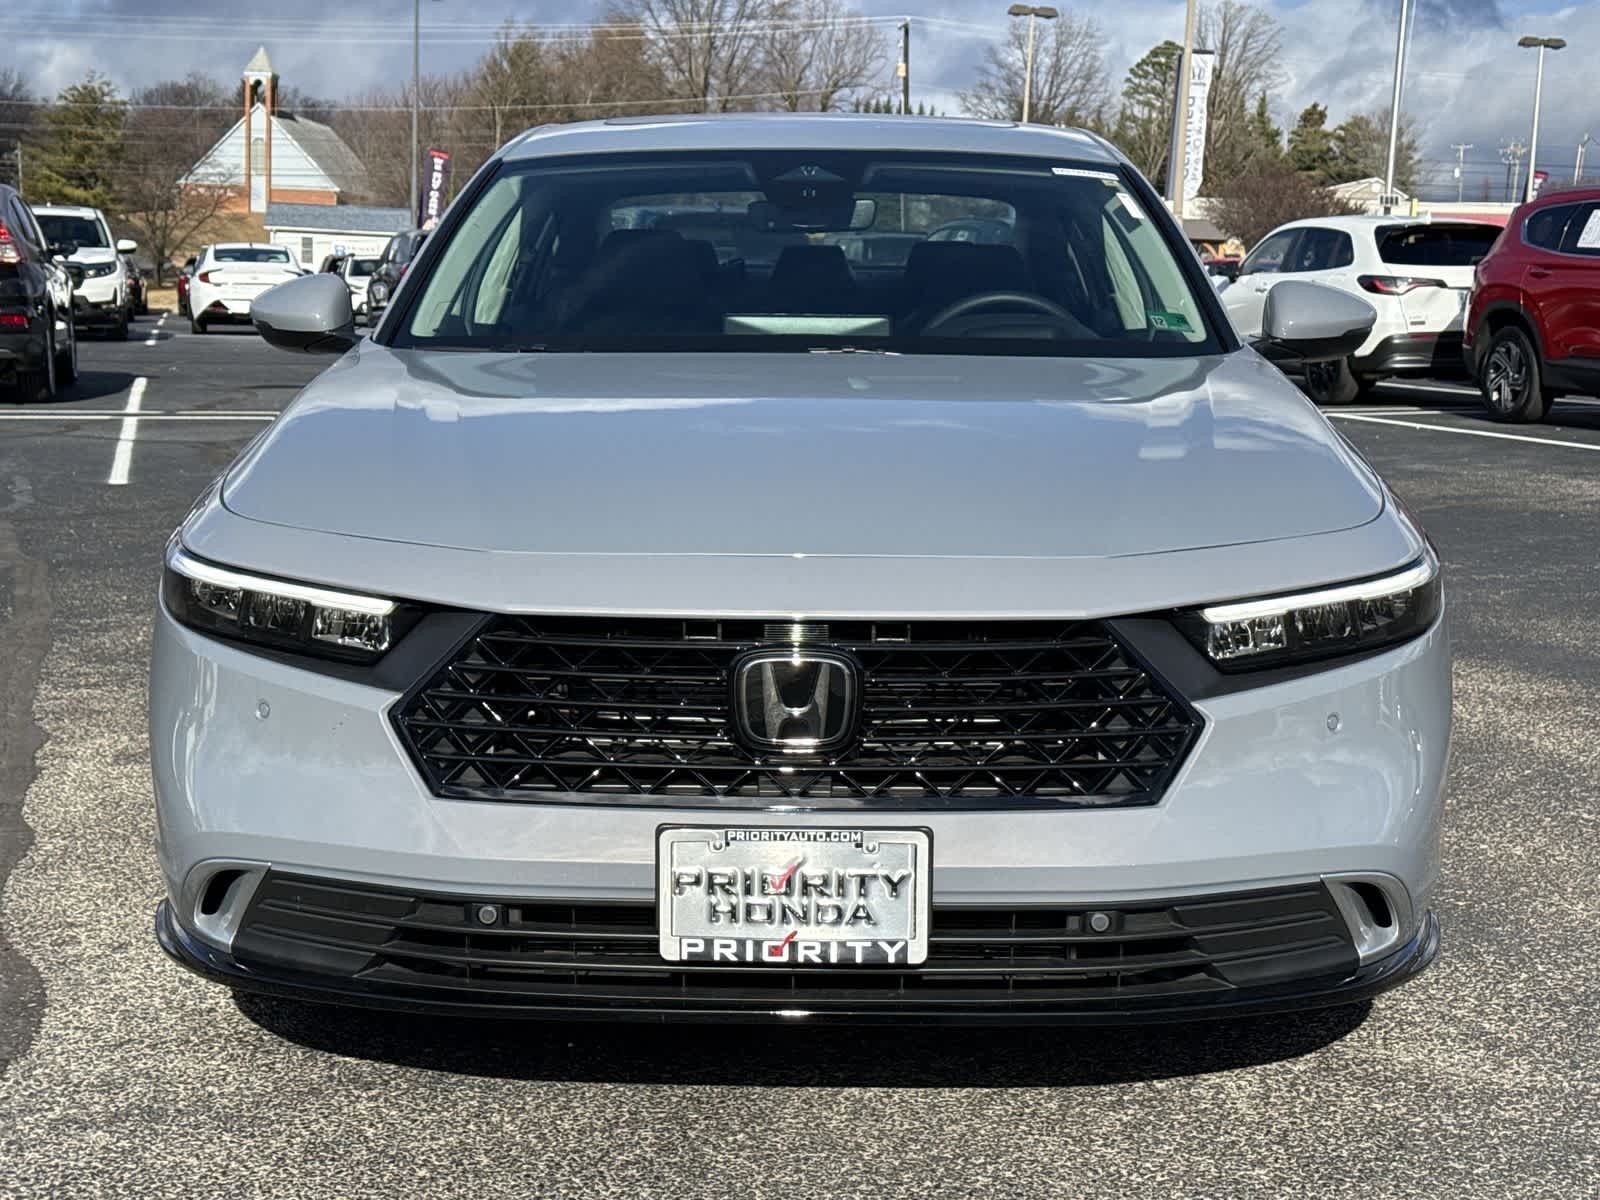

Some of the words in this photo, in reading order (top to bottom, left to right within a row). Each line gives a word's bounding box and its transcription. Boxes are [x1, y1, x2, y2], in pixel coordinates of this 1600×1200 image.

[727, 830, 862, 843] PRIORITYAUTO.COM
[673, 869, 912, 898] PRIORITY
[709, 901, 876, 925] HONDA
[681, 938, 906, 964] PRIORITY
